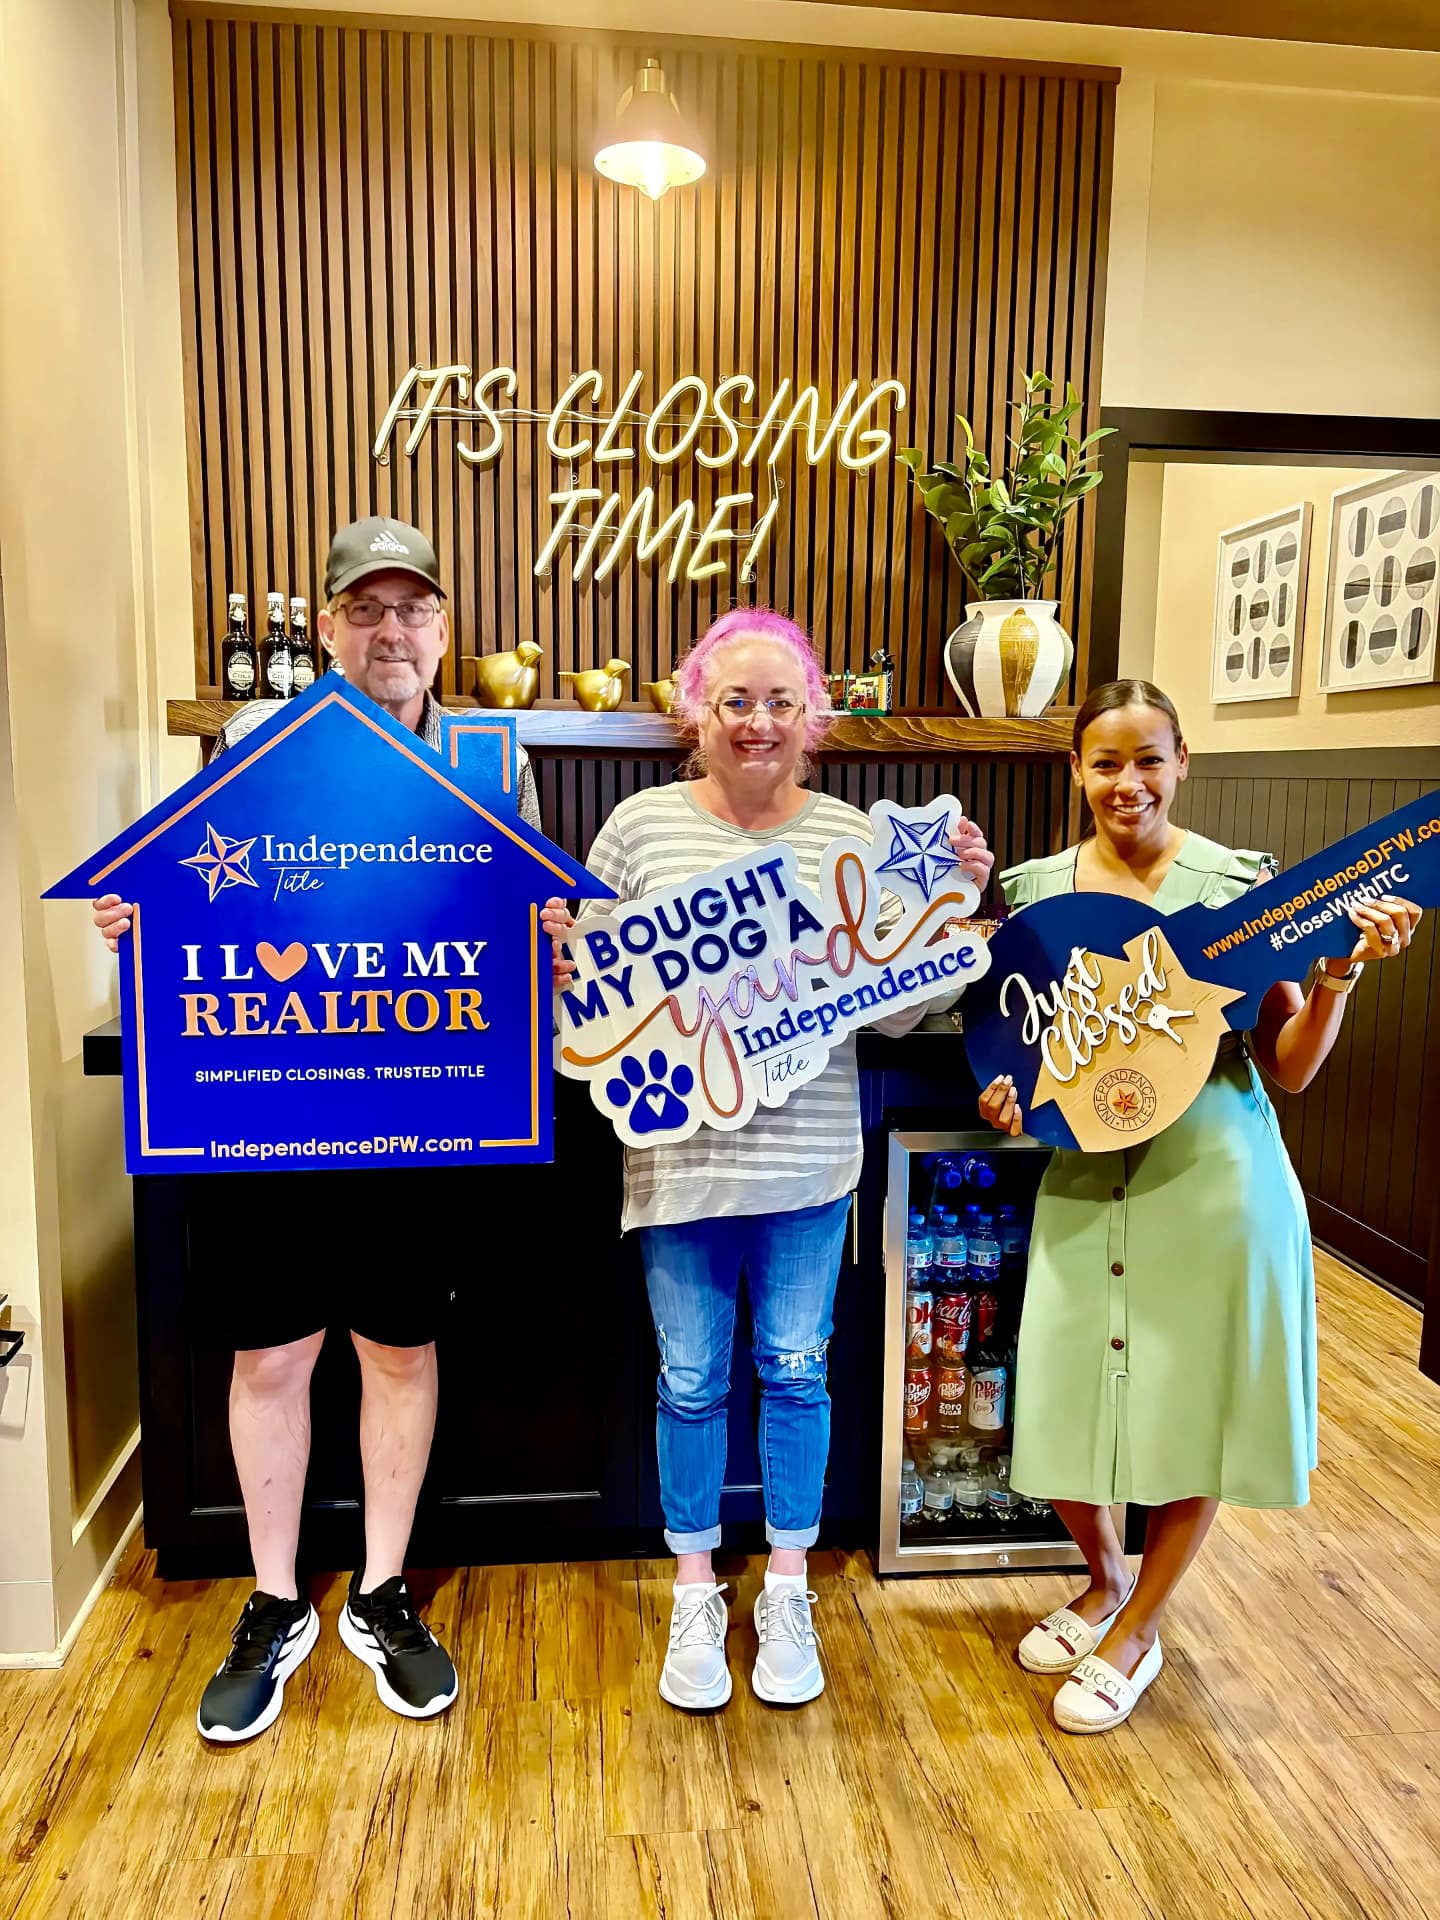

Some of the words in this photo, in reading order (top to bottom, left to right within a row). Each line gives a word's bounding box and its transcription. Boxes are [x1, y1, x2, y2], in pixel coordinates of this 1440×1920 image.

[373, 365, 518, 464] IT'S
[546, 368, 907, 471] CLOSING
[370, 541, 409, 555] adidas
[534, 486, 779, 584] TIME!
[261, 834, 493, 869] Independence
[268, 866, 338, 902] Title
[1202, 816, 1440, 961] www.IndependenceDFW.co
[1269, 863, 1410, 952] #CloseWithITC
[585, 856, 788, 970] BOUGHT
[182, 944, 202, 981] I
[403, 941, 488, 978] MY
[561, 965, 635, 1029] MY
[652, 918, 768, 992] DOG
[788, 900, 824, 942] A
[179, 988, 490, 1038] REALTOR
[733, 945, 977, 1060] Independence
[1000, 945, 1103, 1046] Just
[1040, 931, 1168, 1083] Closed
[195, 1068, 282, 1083] SIMPLIFIED
[286, 1066, 371, 1082] CLOSINGS.
[374, 1065, 442, 1080] TRUSTED
[445, 1064, 485, 1079] TITLE
[752, 1041, 816, 1097] Title
[1096, 1070, 1155, 1125] INDEPENDENCE
[1121, 1108, 1152, 1129] TITLE
[210, 1135, 473, 1159] IndependenceDFW.com
[908, 1382, 922, 1394] Dr
[1046, 1615, 1083, 1643] GUCCI
[1075, 1663, 1121, 1697] GUCCI
